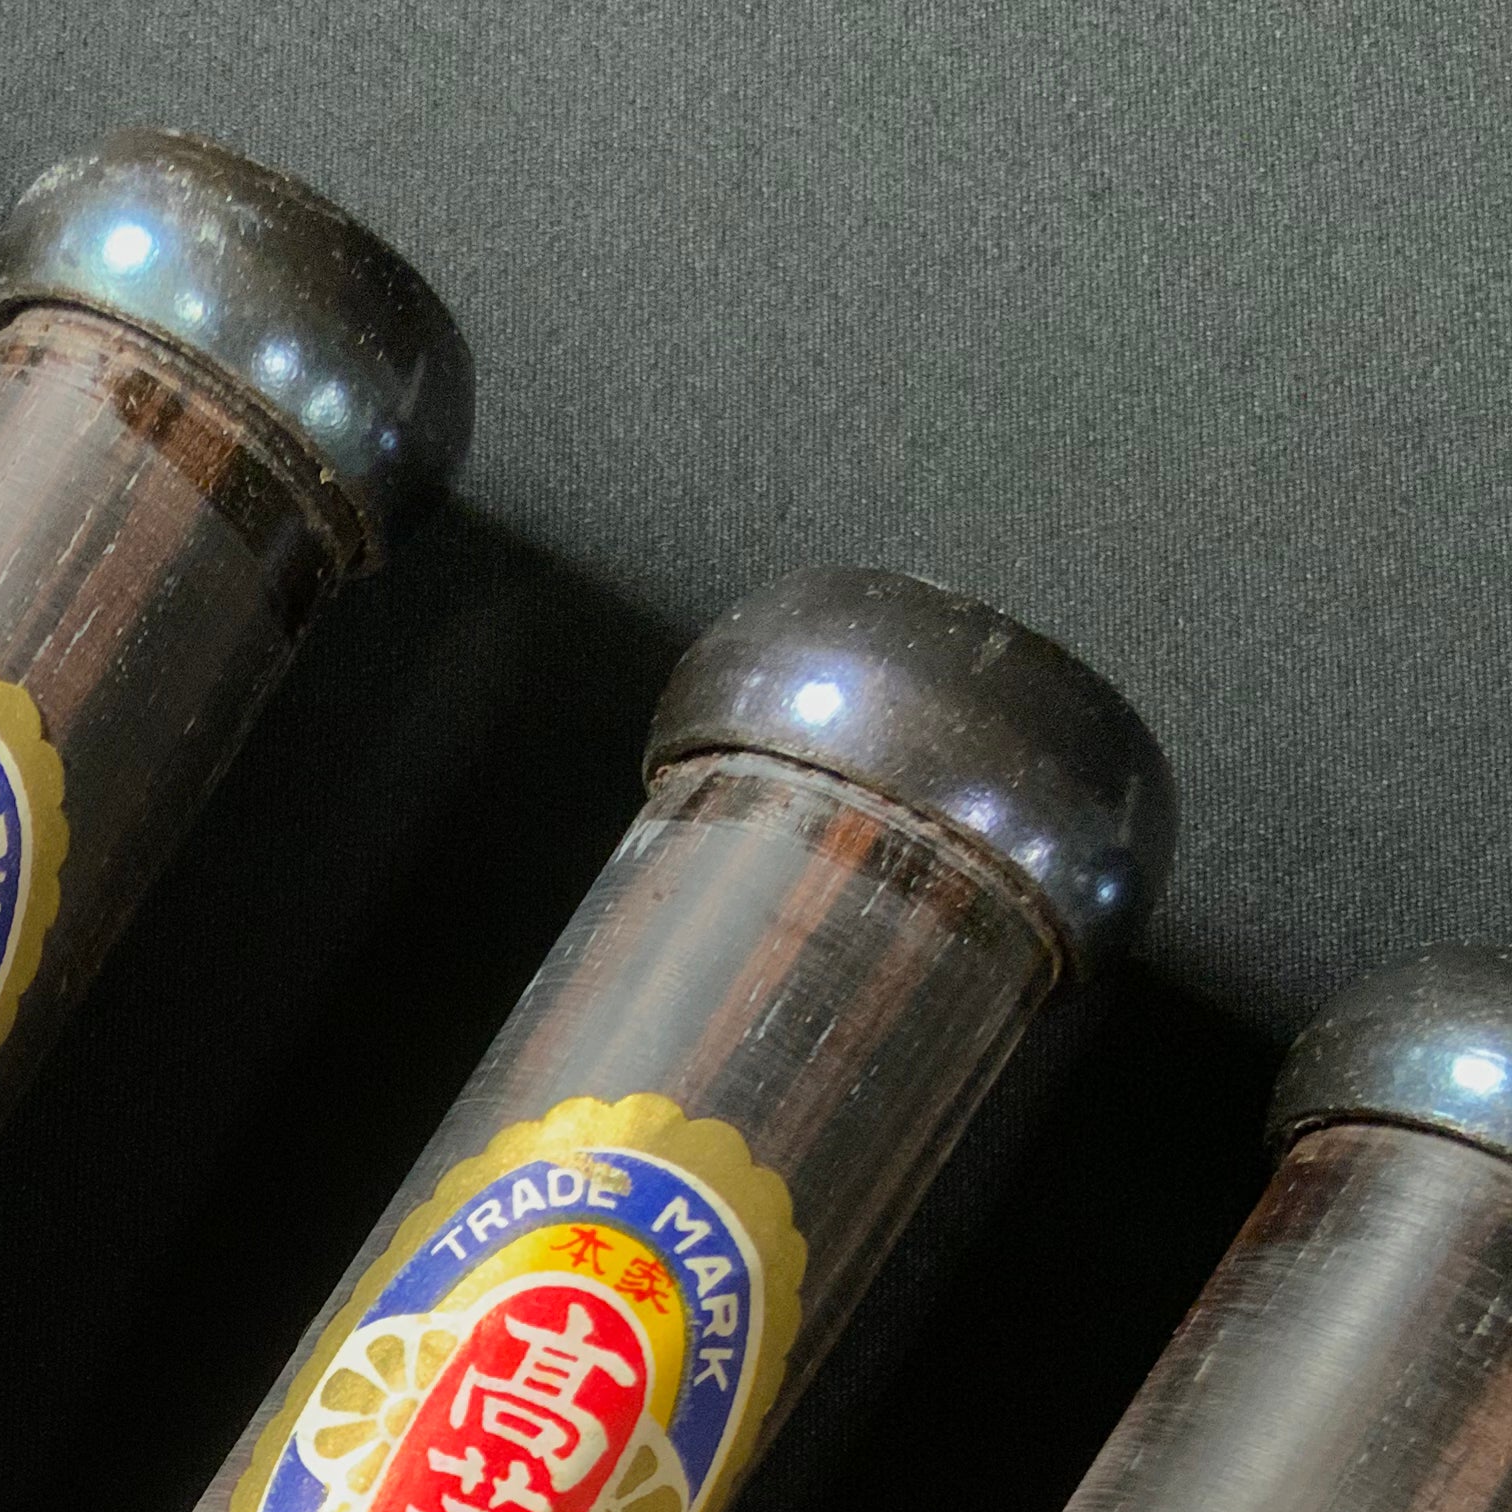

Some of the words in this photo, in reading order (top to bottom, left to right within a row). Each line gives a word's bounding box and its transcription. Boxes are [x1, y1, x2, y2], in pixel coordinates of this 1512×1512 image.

[430, 1166, 620, 1261] TRADE
[650, 1196, 739, 1392] MARK
[550, 1226, 673, 1314] 本家
